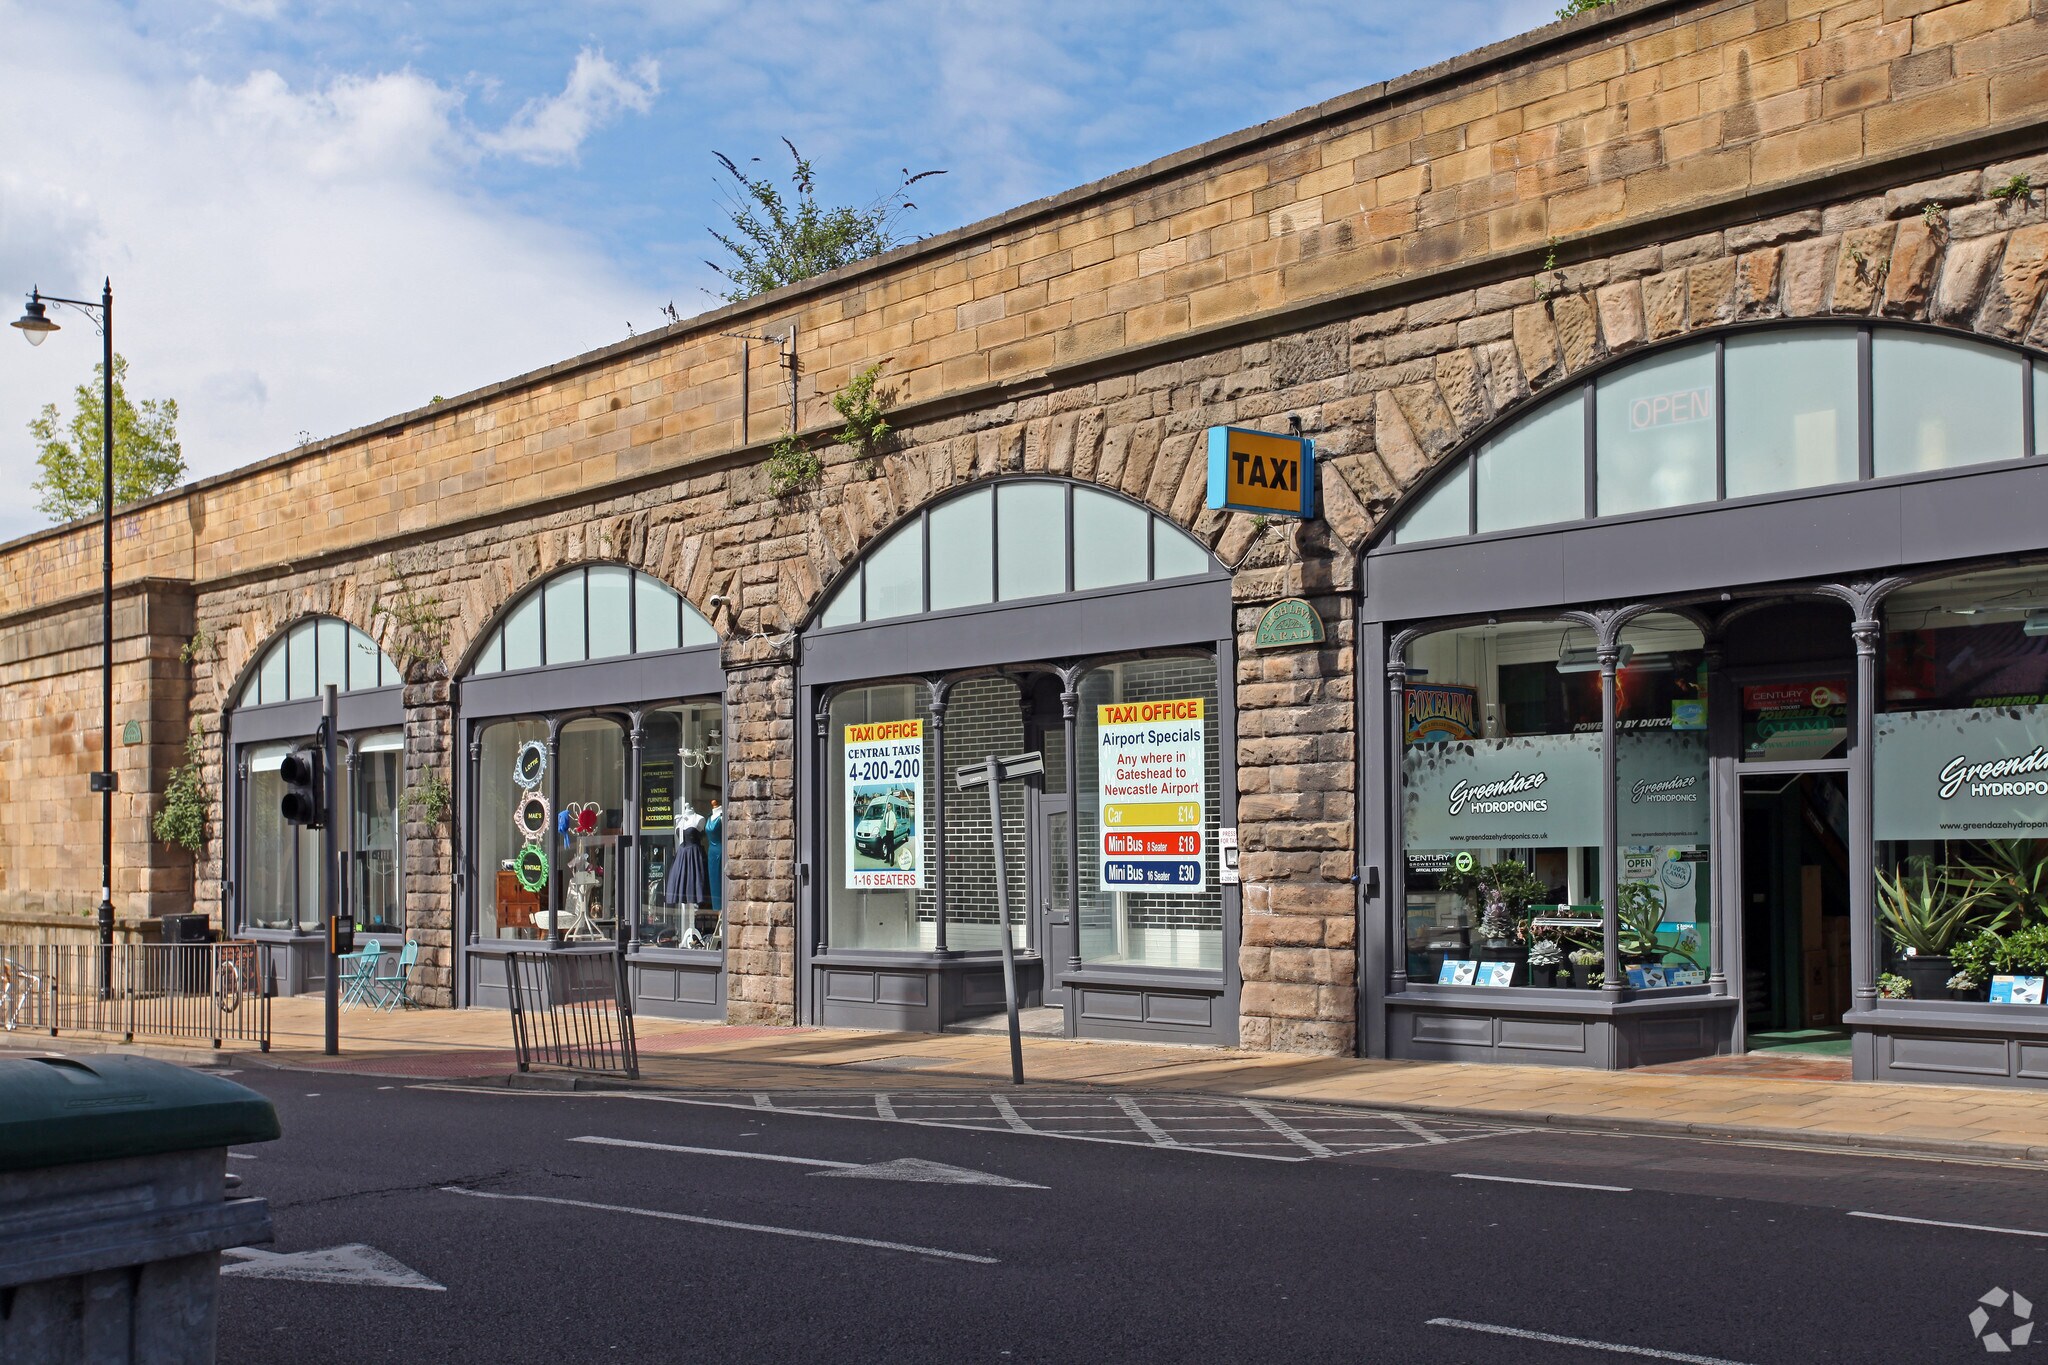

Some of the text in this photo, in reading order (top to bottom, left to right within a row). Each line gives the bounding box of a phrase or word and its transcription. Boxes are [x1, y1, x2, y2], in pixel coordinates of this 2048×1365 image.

[1632, 389, 1709, 428] OPEN
[1232, 451, 1298, 492] TAXI
[1263, 605, 1314, 632] HIGH LEVEL
[1261, 629, 1319, 643] PARADE
[1753, 690, 1803, 700] CENTURY
[1972, 695, 2039, 708] POWERED
[1105, 701, 1198, 723] TAXI OFFICE
[1623, 719, 1639, 729] BY
[1639, 717, 1673, 728] DUTCH
[1763, 720, 1829, 735] ATAMI
[850, 722, 918, 742] TAXI OFFICE
[1103, 728, 1201, 748] Airport Specials
[848, 744, 921, 759] CENTRAL TAXIS
[1117, 751, 1186, 767] Any where in
[524, 757, 539, 772] LOTTIE
[849, 759, 920, 781] 4-200-200
[1116, 766, 1186, 780] Gateshead to
[1104, 782, 1199, 797] Newcastle Airport
[1449, 771, 1548, 816] Greendaze
[1631, 775, 1697, 804] Greendaze
[1971, 780, 2048, 797] HYDROPO
[1646, 793, 1697, 802] HYDROPONICS
[1107, 805, 1194, 823] Car £14
[1471, 800, 1548, 814] HYDROPONICS
[527, 812, 542, 820] MAE'S
[1108, 835, 1125, 852] Mini
[1127, 835, 1143, 852] Bus
[1151, 841, 1168, 852] Seater
[1178, 835, 1195, 852] £18
[1449, 832, 1548, 842] www.greendazehydroponics.co.uk
[1409, 854, 1450, 862] CENTURY
[1627, 859, 1652, 868] OPEN
[853, 874, 916, 886] 1-16 SEATERS
[1108, 864, 1195, 881] Mini Bus 16 Seater £30
[1665, 868, 1687, 881] CANNA
